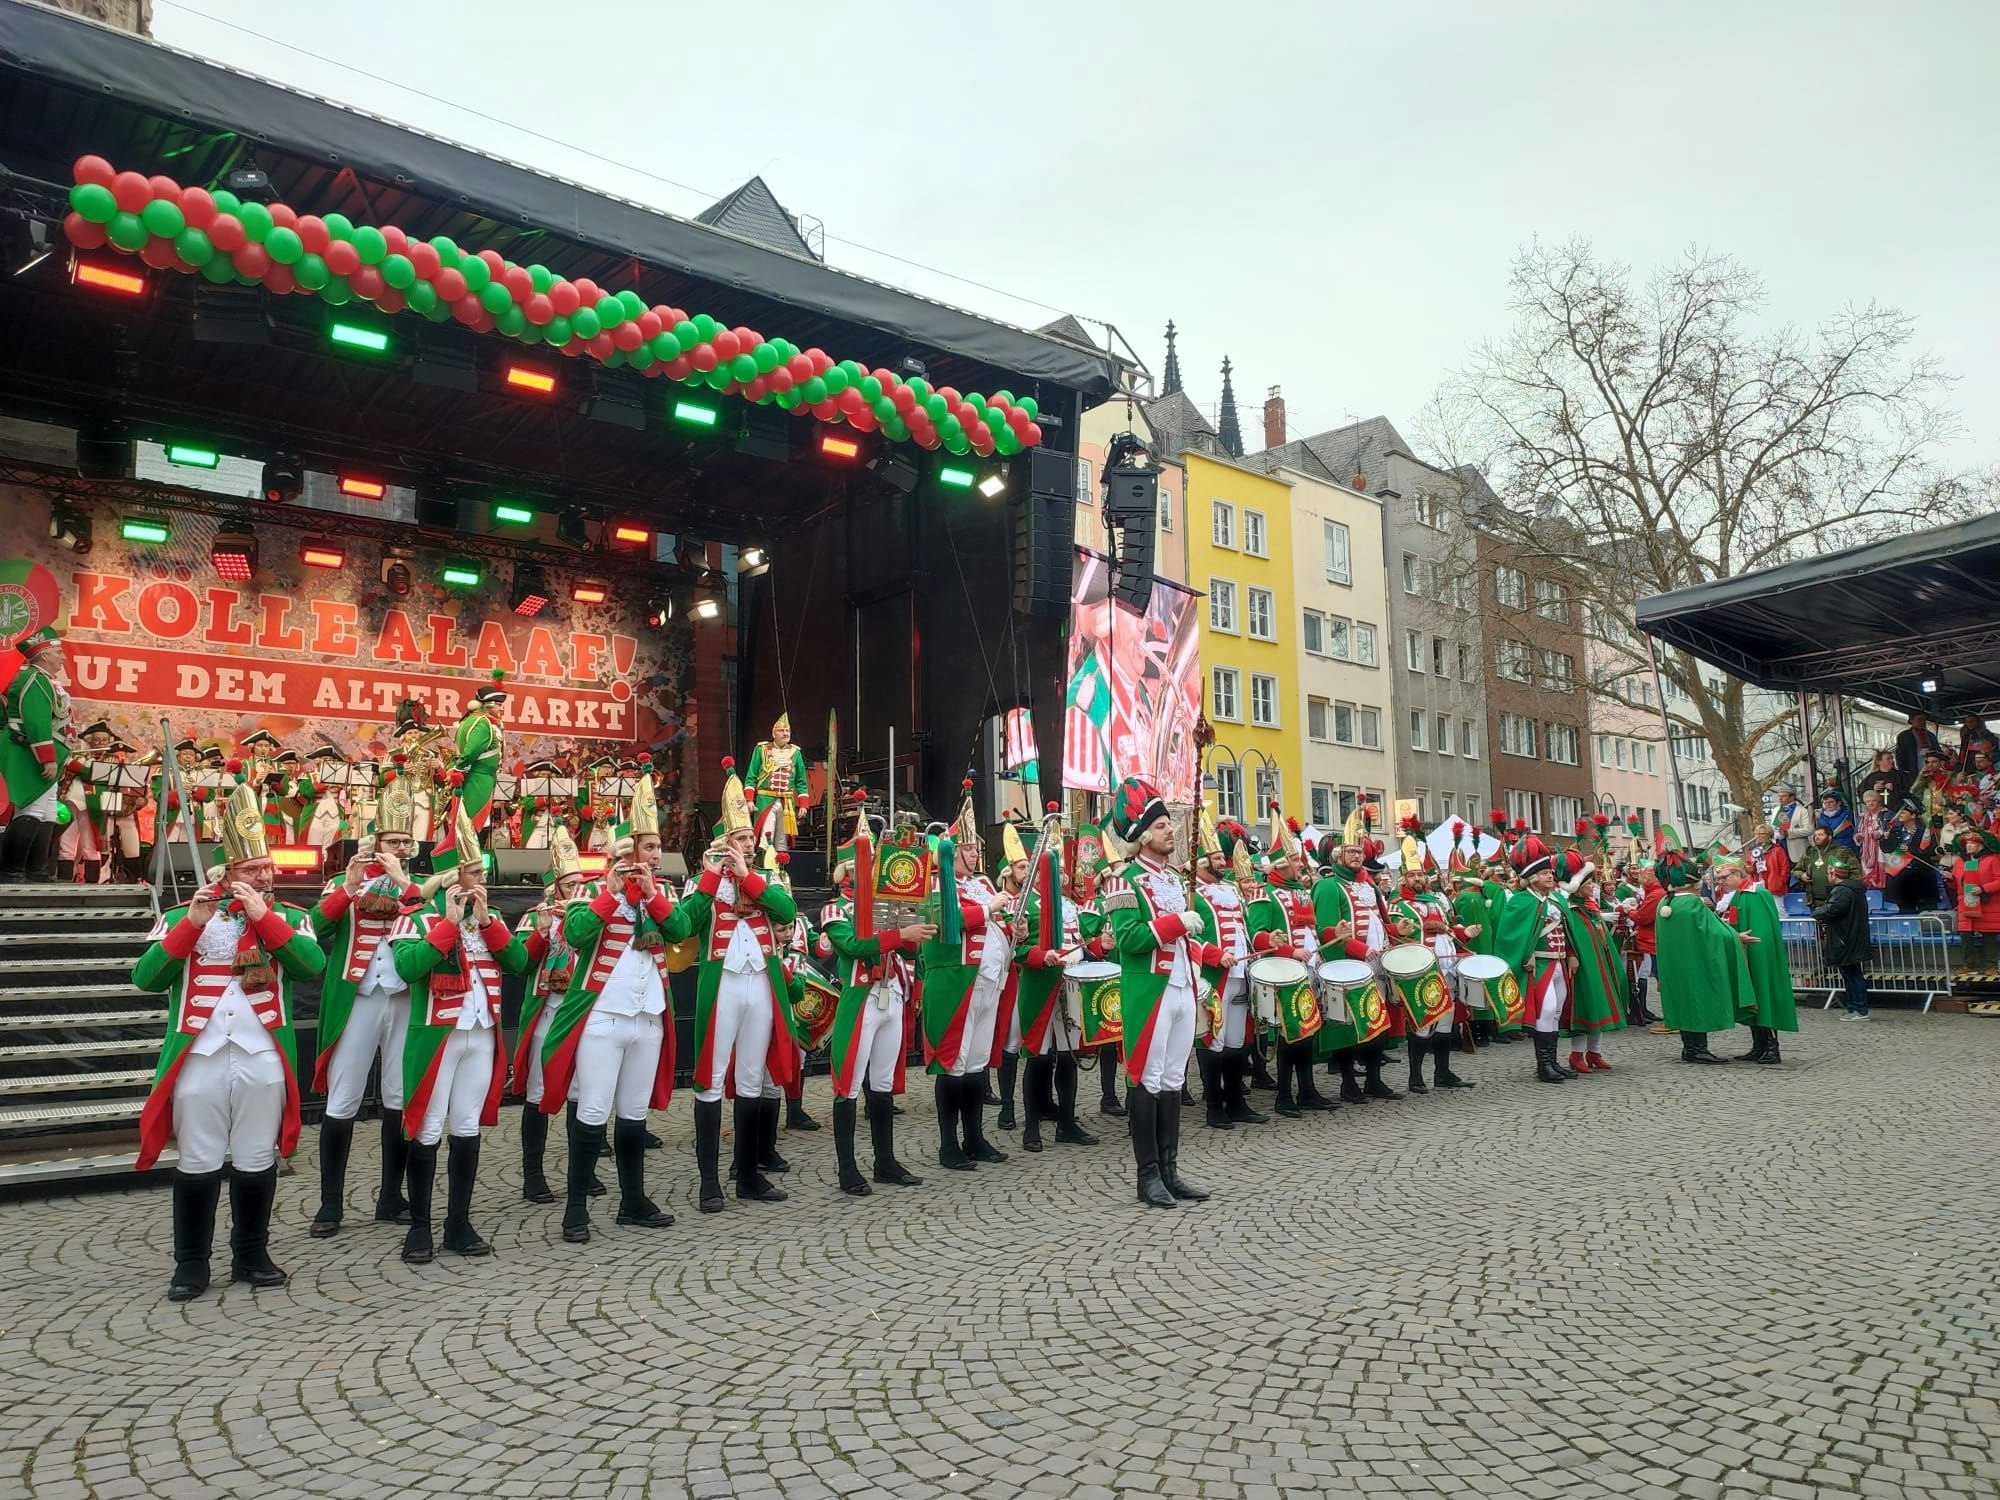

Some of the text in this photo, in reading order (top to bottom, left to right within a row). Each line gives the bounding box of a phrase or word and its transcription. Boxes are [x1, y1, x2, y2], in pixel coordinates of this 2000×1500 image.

[69, 565, 637, 701] KÖLLE ALAAF!
[176, 664, 286, 705] DEM
